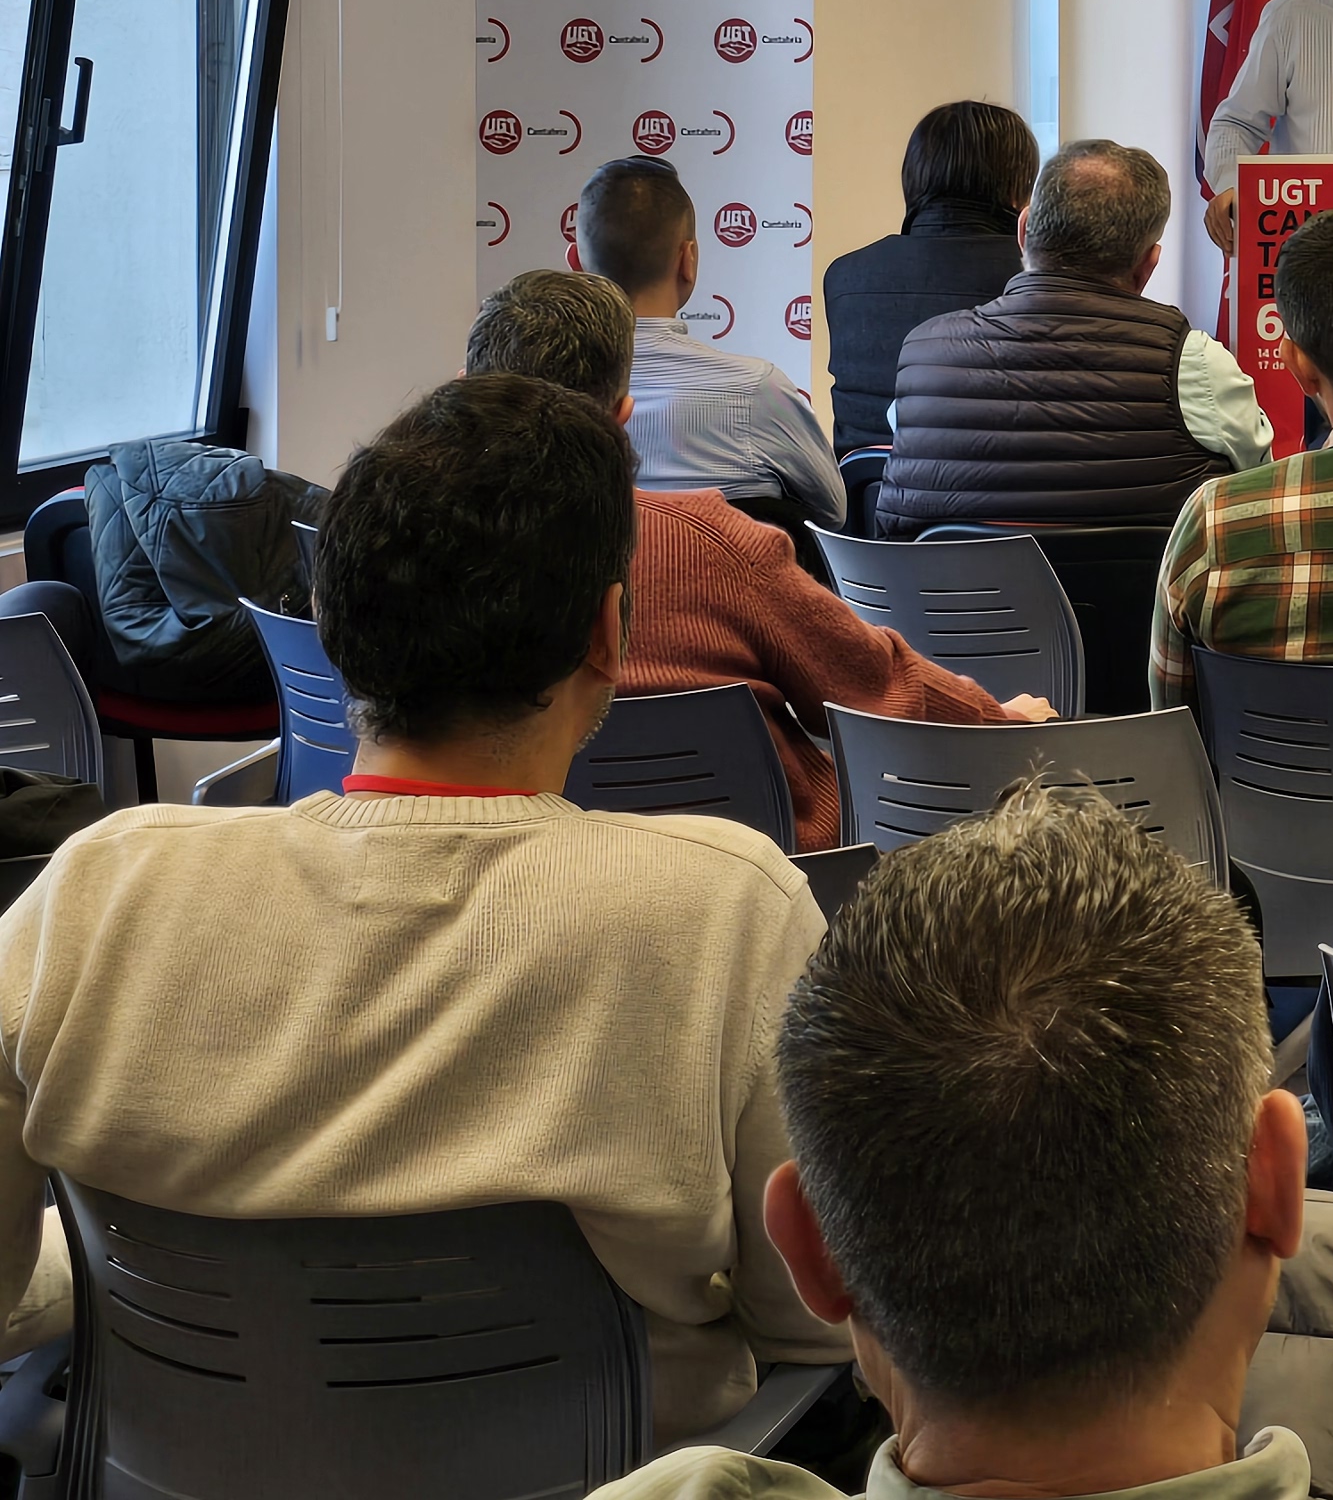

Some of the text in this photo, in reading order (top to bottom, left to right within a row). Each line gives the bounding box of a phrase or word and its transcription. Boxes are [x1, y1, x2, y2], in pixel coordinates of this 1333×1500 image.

[566, 26, 600, 42] UGT
[719, 26, 753, 42] UGT
[484, 117, 518, 134] UGT
[637, 117, 671, 134] UGT
[1258, 179, 1323, 206] UGT
[719, 210, 753, 227] UGT
[1258, 361, 1269, 370] 17
